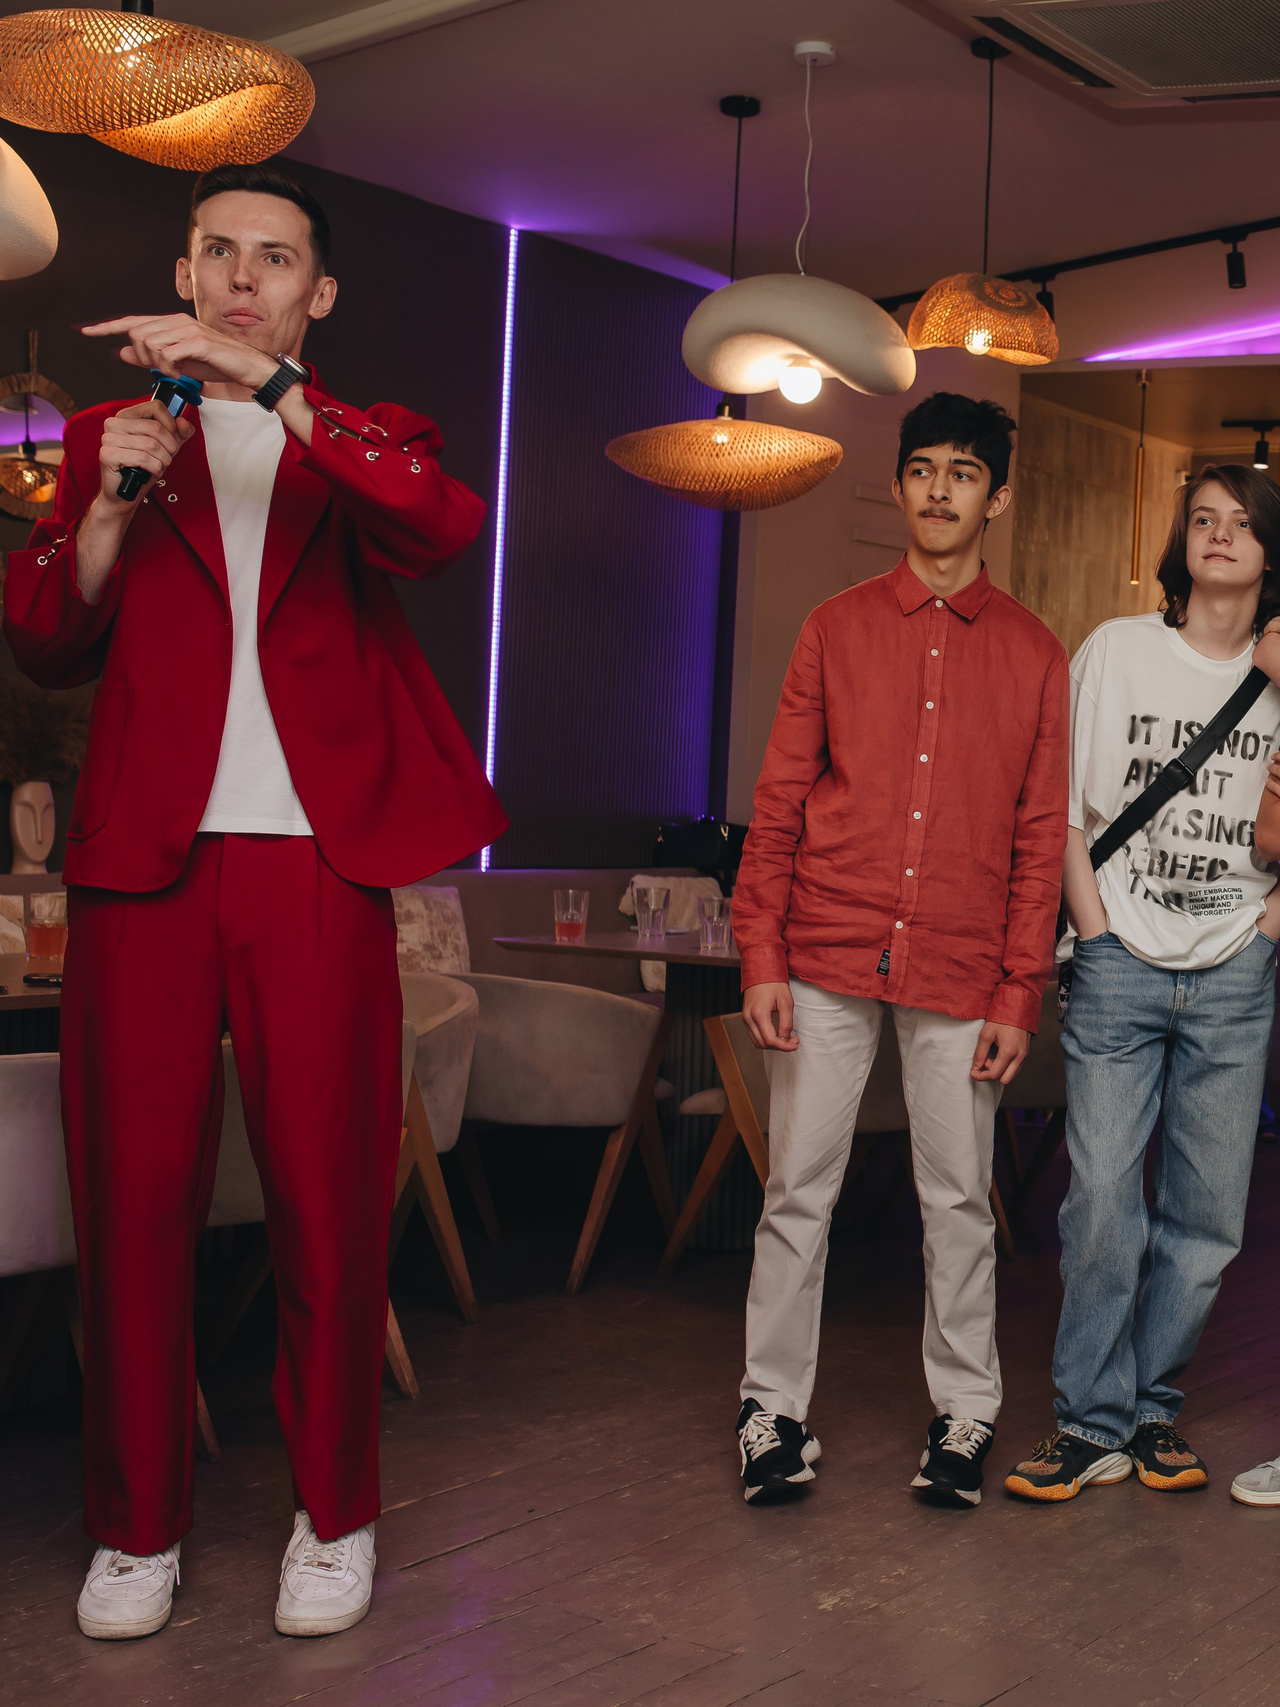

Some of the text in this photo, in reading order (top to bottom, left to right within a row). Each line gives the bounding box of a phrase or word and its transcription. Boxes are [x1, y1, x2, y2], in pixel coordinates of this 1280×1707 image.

[1127, 714, 1274, 762] IT IS NOT
[1204, 888, 1242, 896] EMBRACING
[1210, 894, 1233, 902] MAKES
